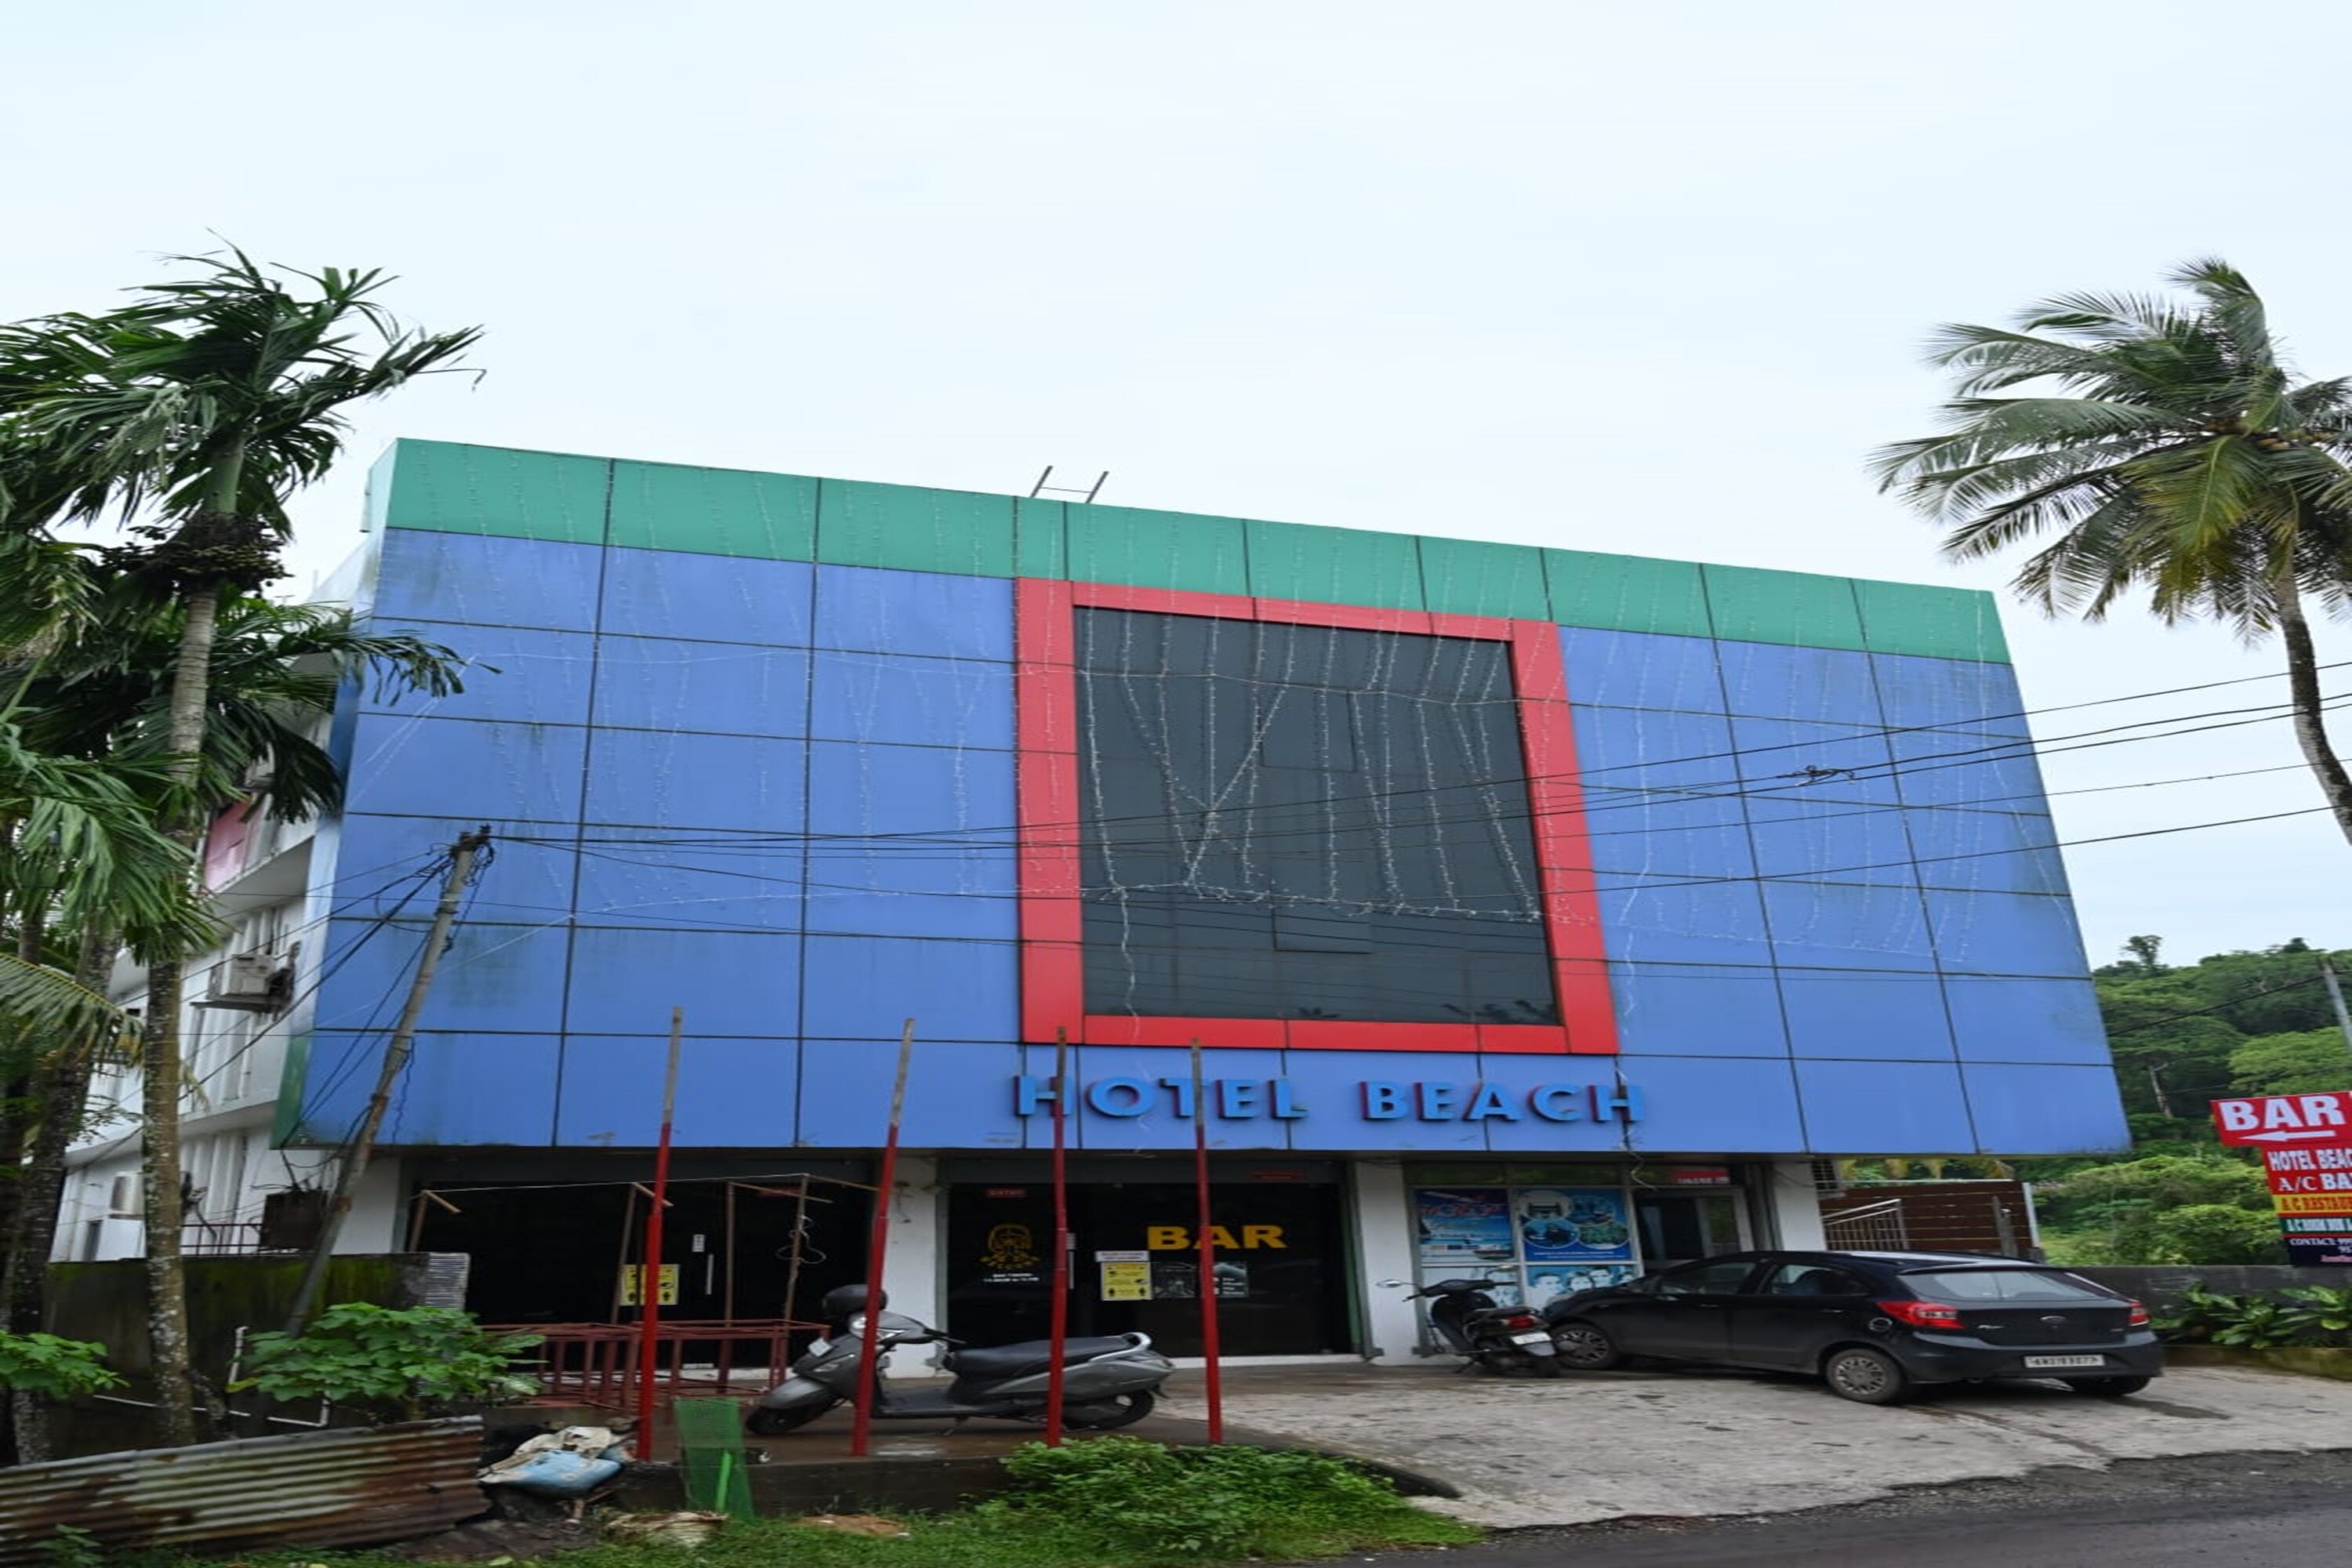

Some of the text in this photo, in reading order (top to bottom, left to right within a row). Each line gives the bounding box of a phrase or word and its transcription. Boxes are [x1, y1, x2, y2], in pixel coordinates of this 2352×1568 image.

[1013, 1075, 1645, 1123] HOTEL BEACH
[2219, 1095, 2347, 1131] BAR
[2267, 1149, 2317, 1171] HOTEL
[2278, 1176, 2318, 1192] A/C
[1146, 1224, 1289, 1250] BAR
